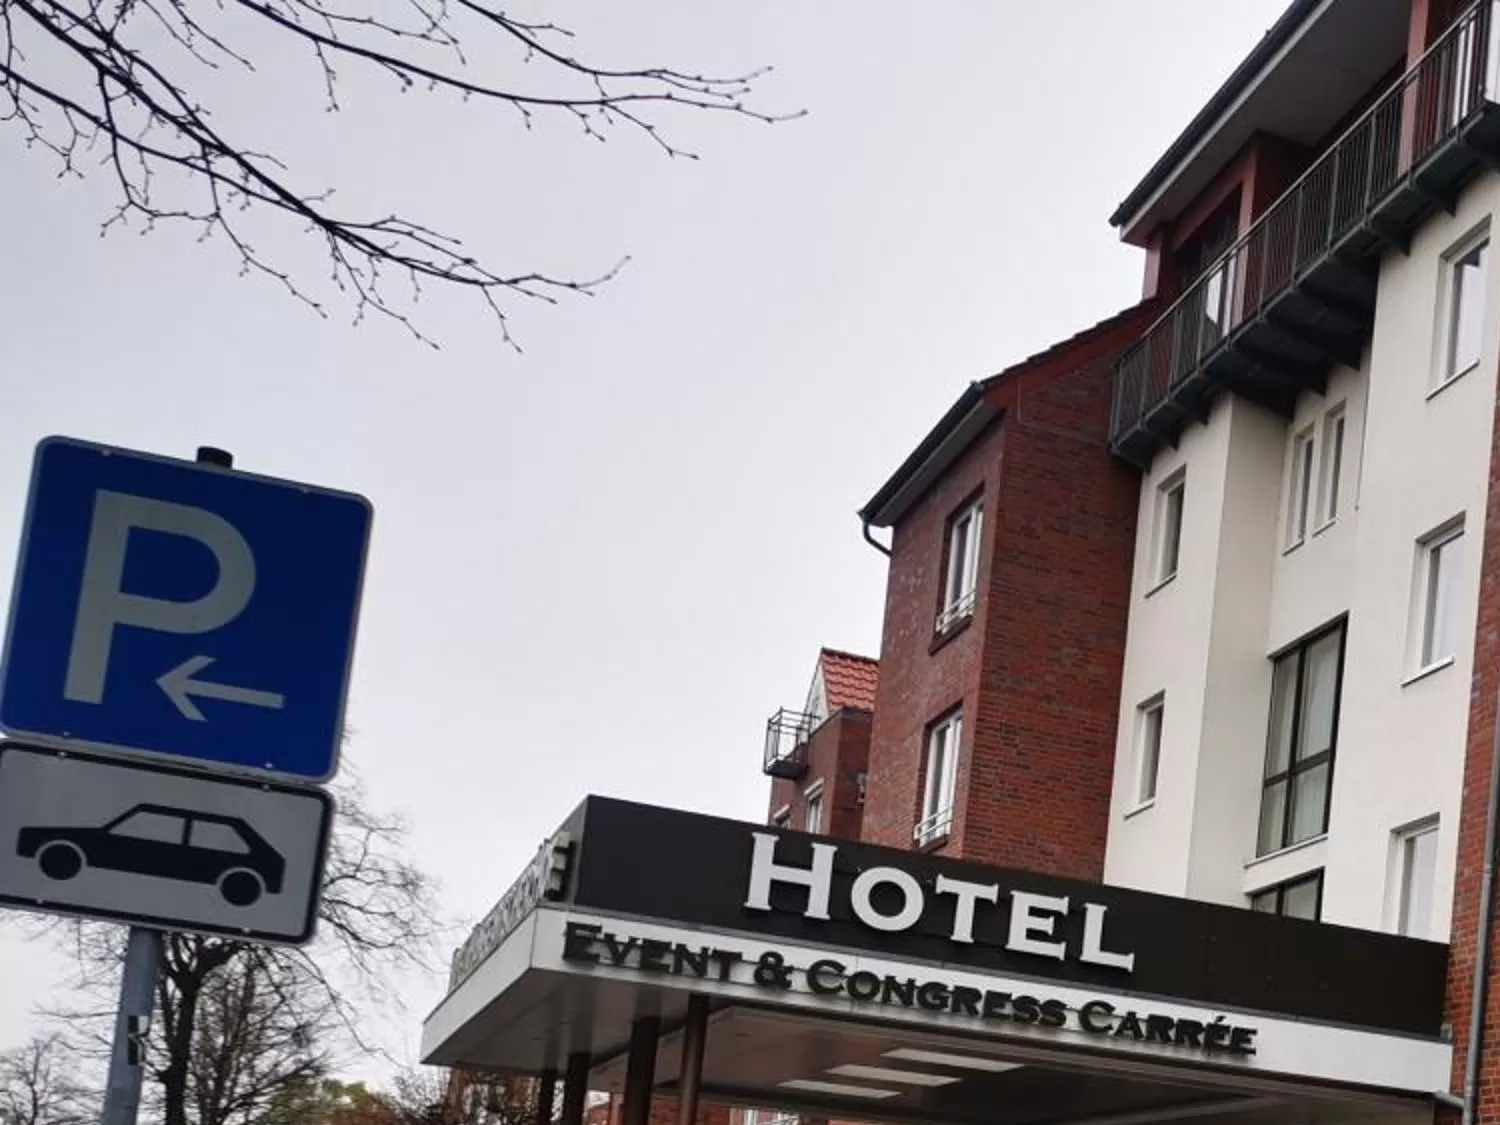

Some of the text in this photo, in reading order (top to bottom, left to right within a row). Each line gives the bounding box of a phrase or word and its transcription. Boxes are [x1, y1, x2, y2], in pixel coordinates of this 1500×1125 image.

[63, 488, 257, 705] P
[741, 829, 1137, 975] HOTEL
[562, 920, 1259, 1057] EVENT & CONGRESS CARRÉE
